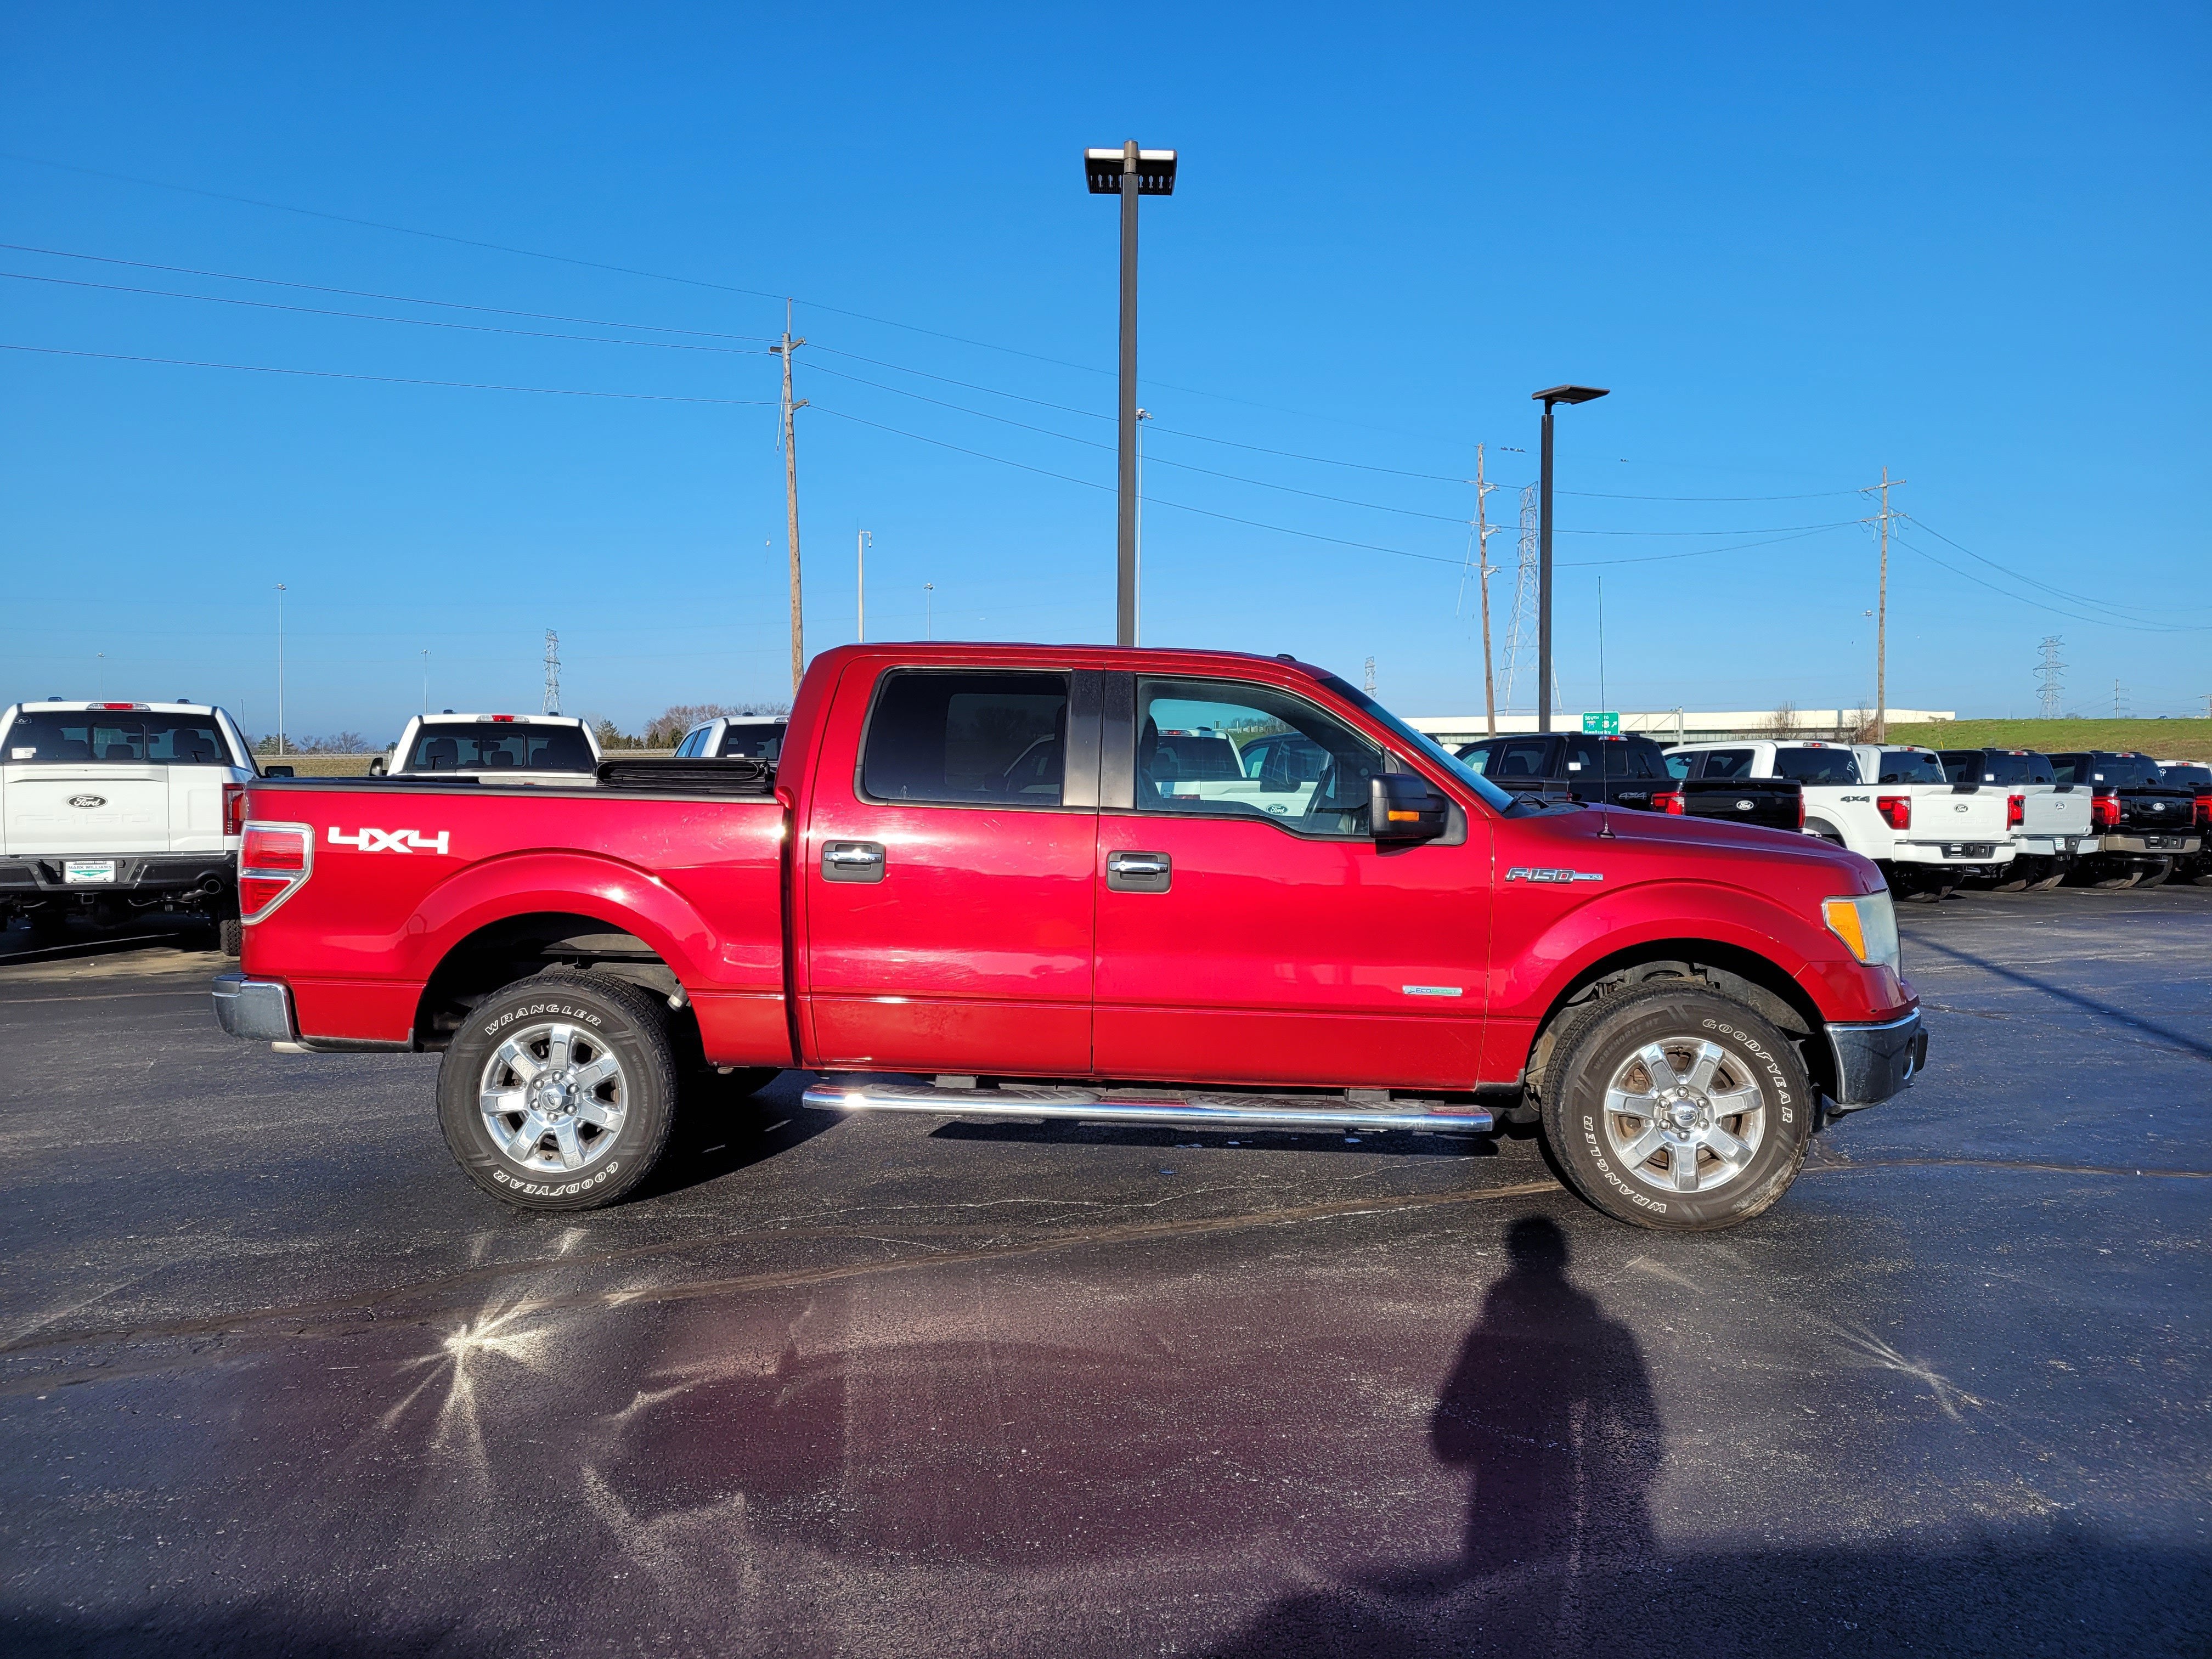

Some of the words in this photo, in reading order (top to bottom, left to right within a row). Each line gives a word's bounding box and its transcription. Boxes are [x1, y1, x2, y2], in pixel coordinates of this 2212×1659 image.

[1505, 867, 1576, 883] F-150
[485, 1005, 601, 1035] WRANGLER
[1702, 1019, 1793, 1124] GOODYEAR
[493, 1161, 618, 1196] GOODYEAR
[1584, 1115, 1667, 1214] WRANGLER
